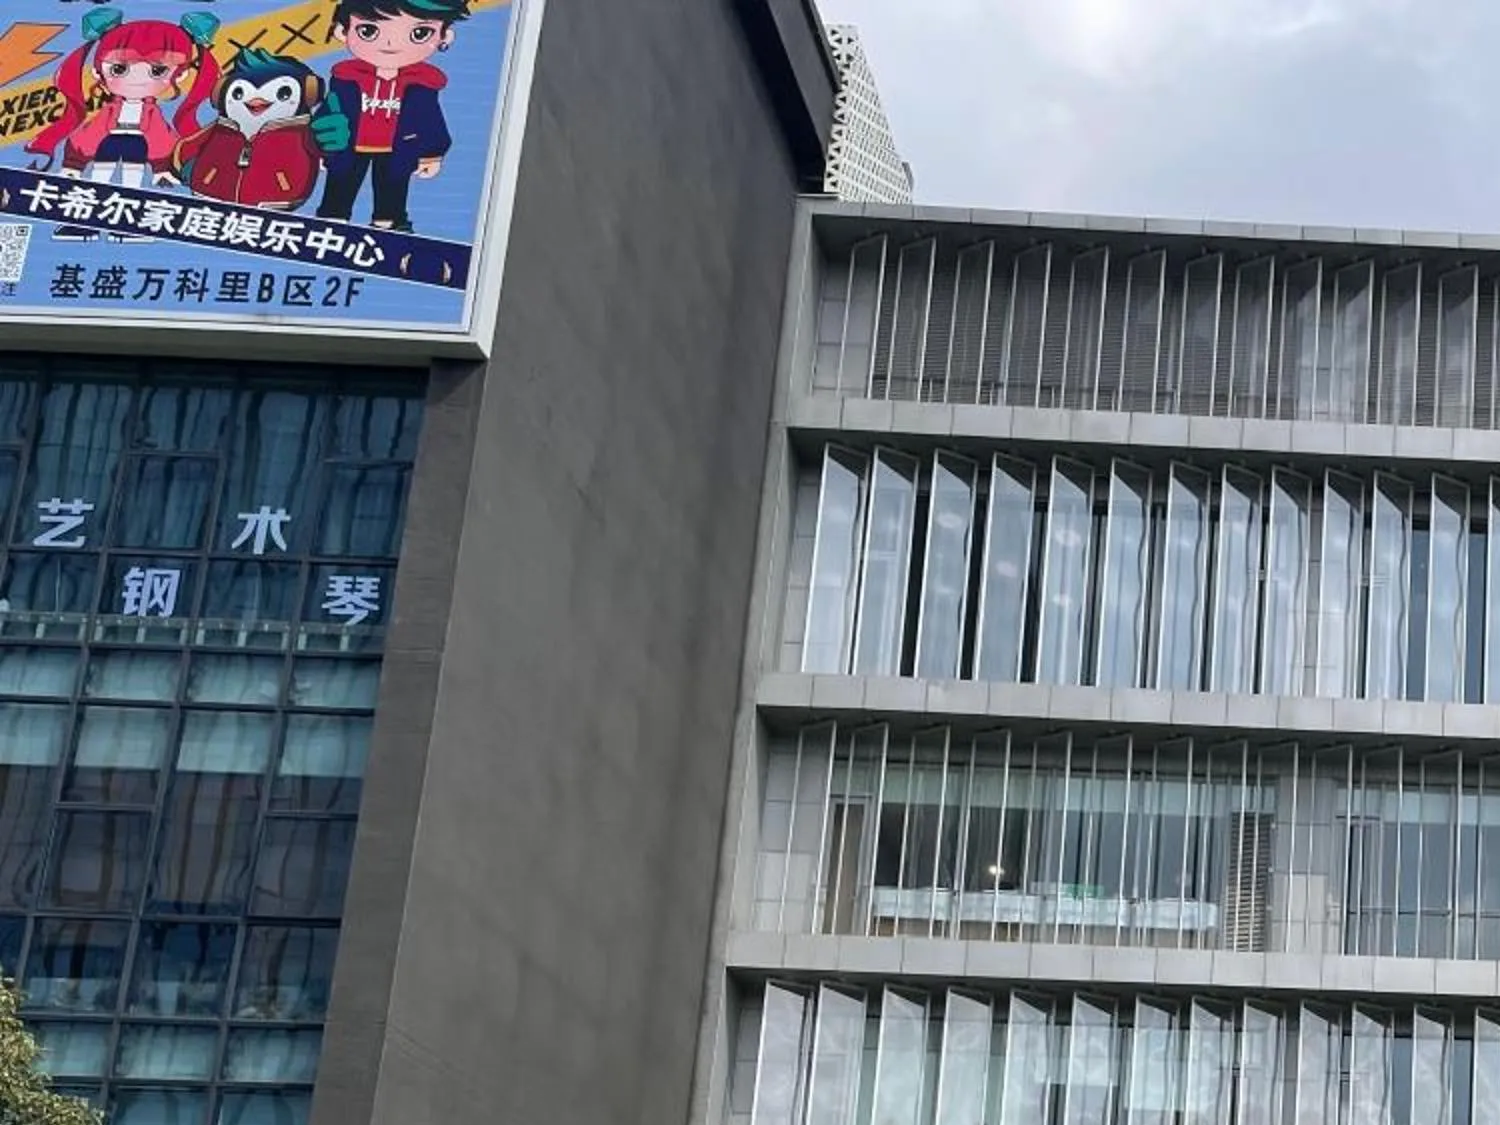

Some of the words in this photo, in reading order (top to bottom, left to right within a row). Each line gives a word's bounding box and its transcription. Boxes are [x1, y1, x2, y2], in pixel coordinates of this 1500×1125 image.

[20, 180, 385, 268] 卡希尔家庭娱乐中心
[49, 263, 364, 307] 基盛万科里B区2F
